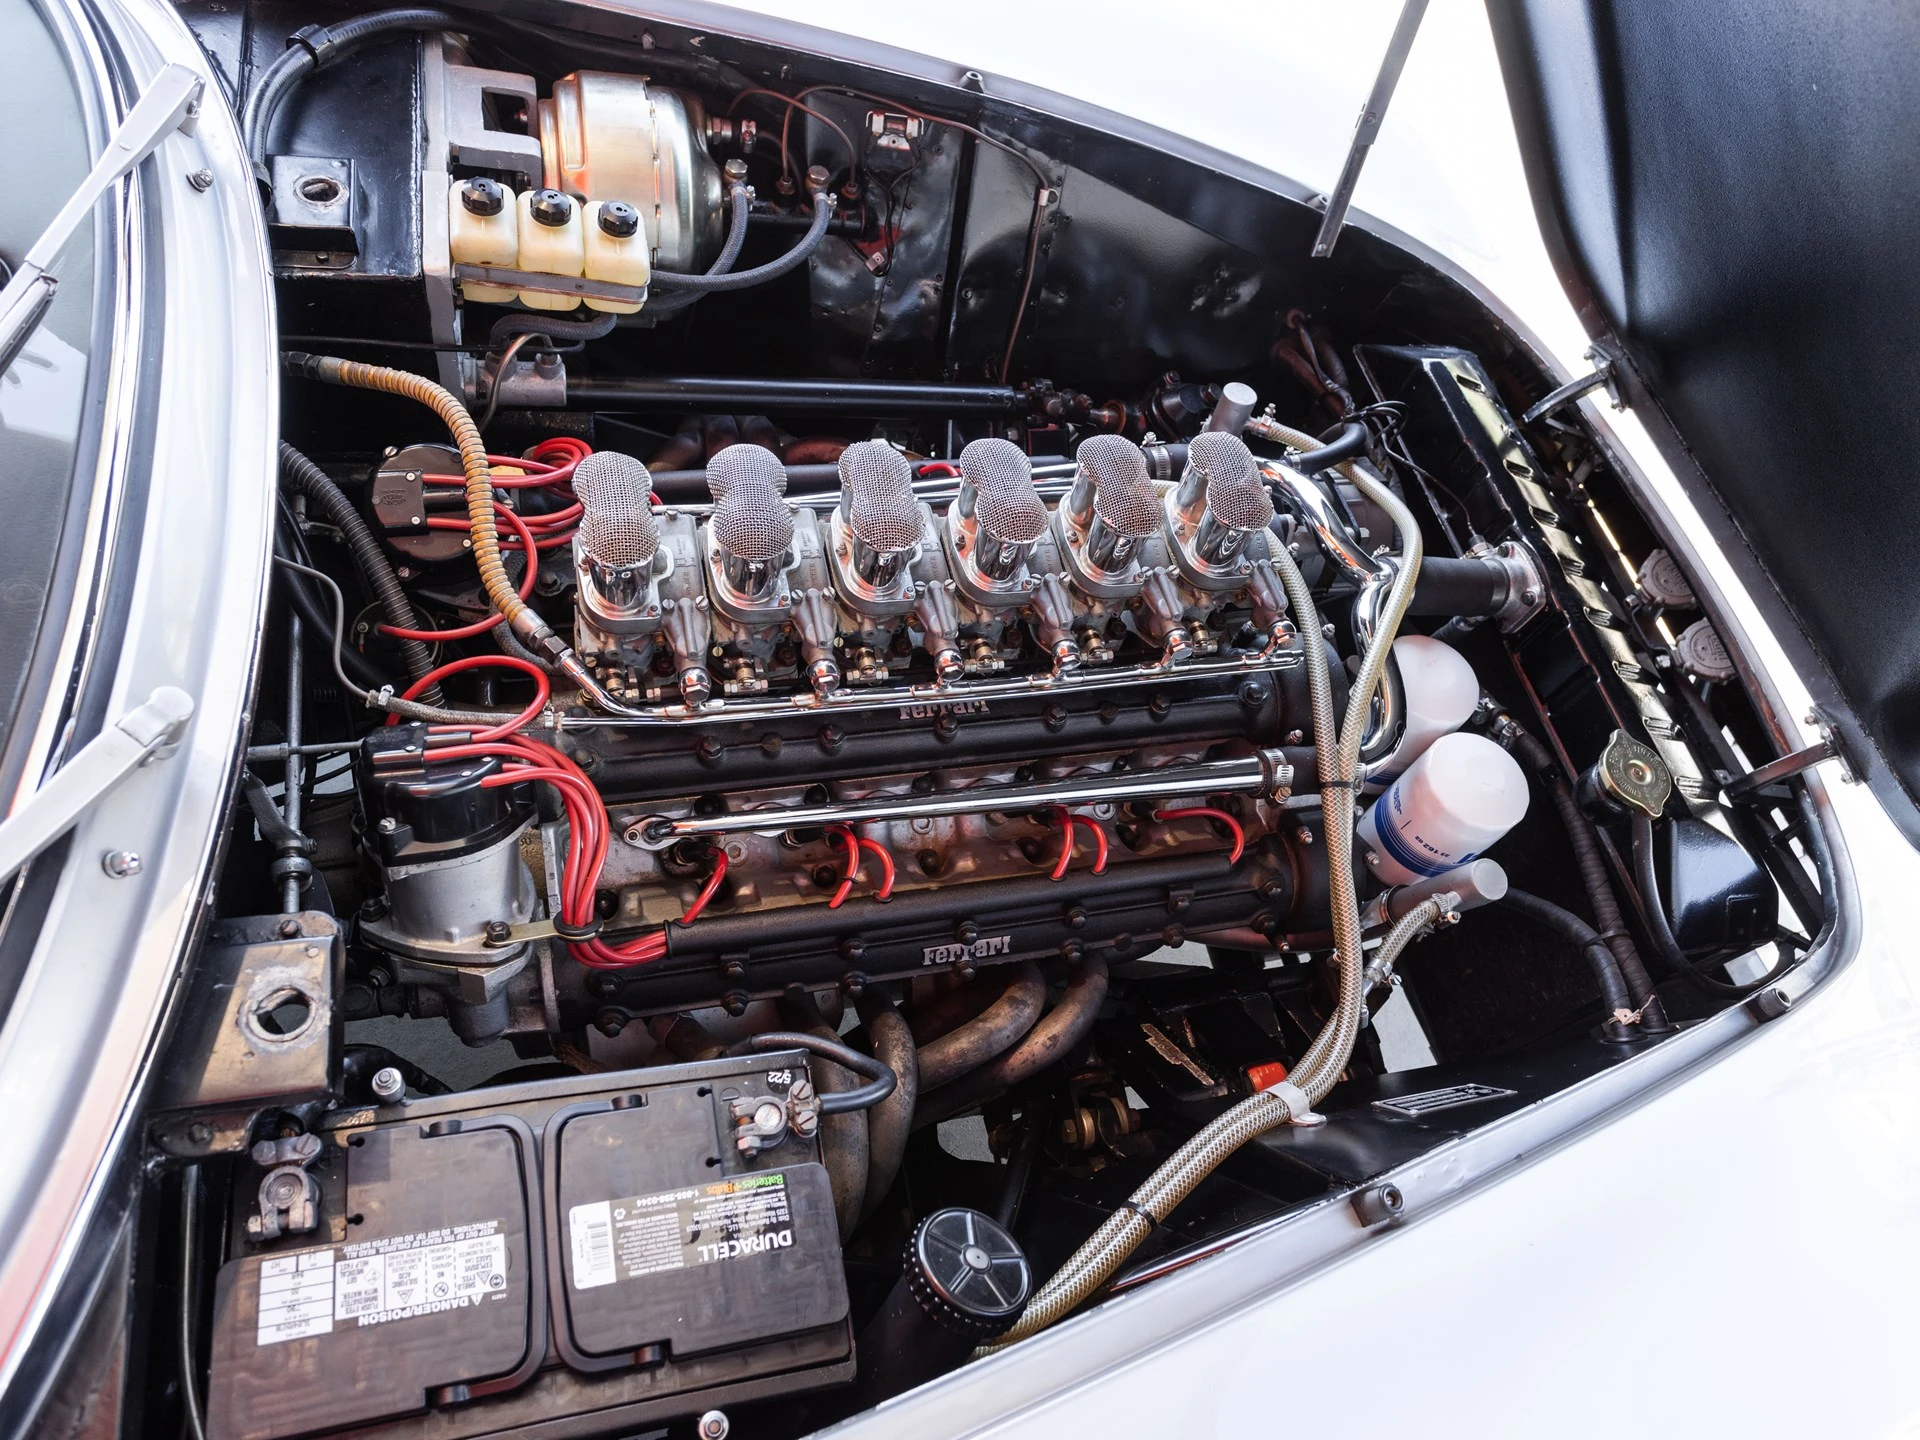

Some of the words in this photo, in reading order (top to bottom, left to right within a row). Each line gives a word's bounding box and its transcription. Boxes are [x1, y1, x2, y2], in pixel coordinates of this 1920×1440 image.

[922, 935, 1011, 965] Ferrari
[767, 1069, 791, 1084] 5/22
[698, 1230, 792, 1262] DURACELL
[358, 1297, 468, 1325] DANGER/POISON
